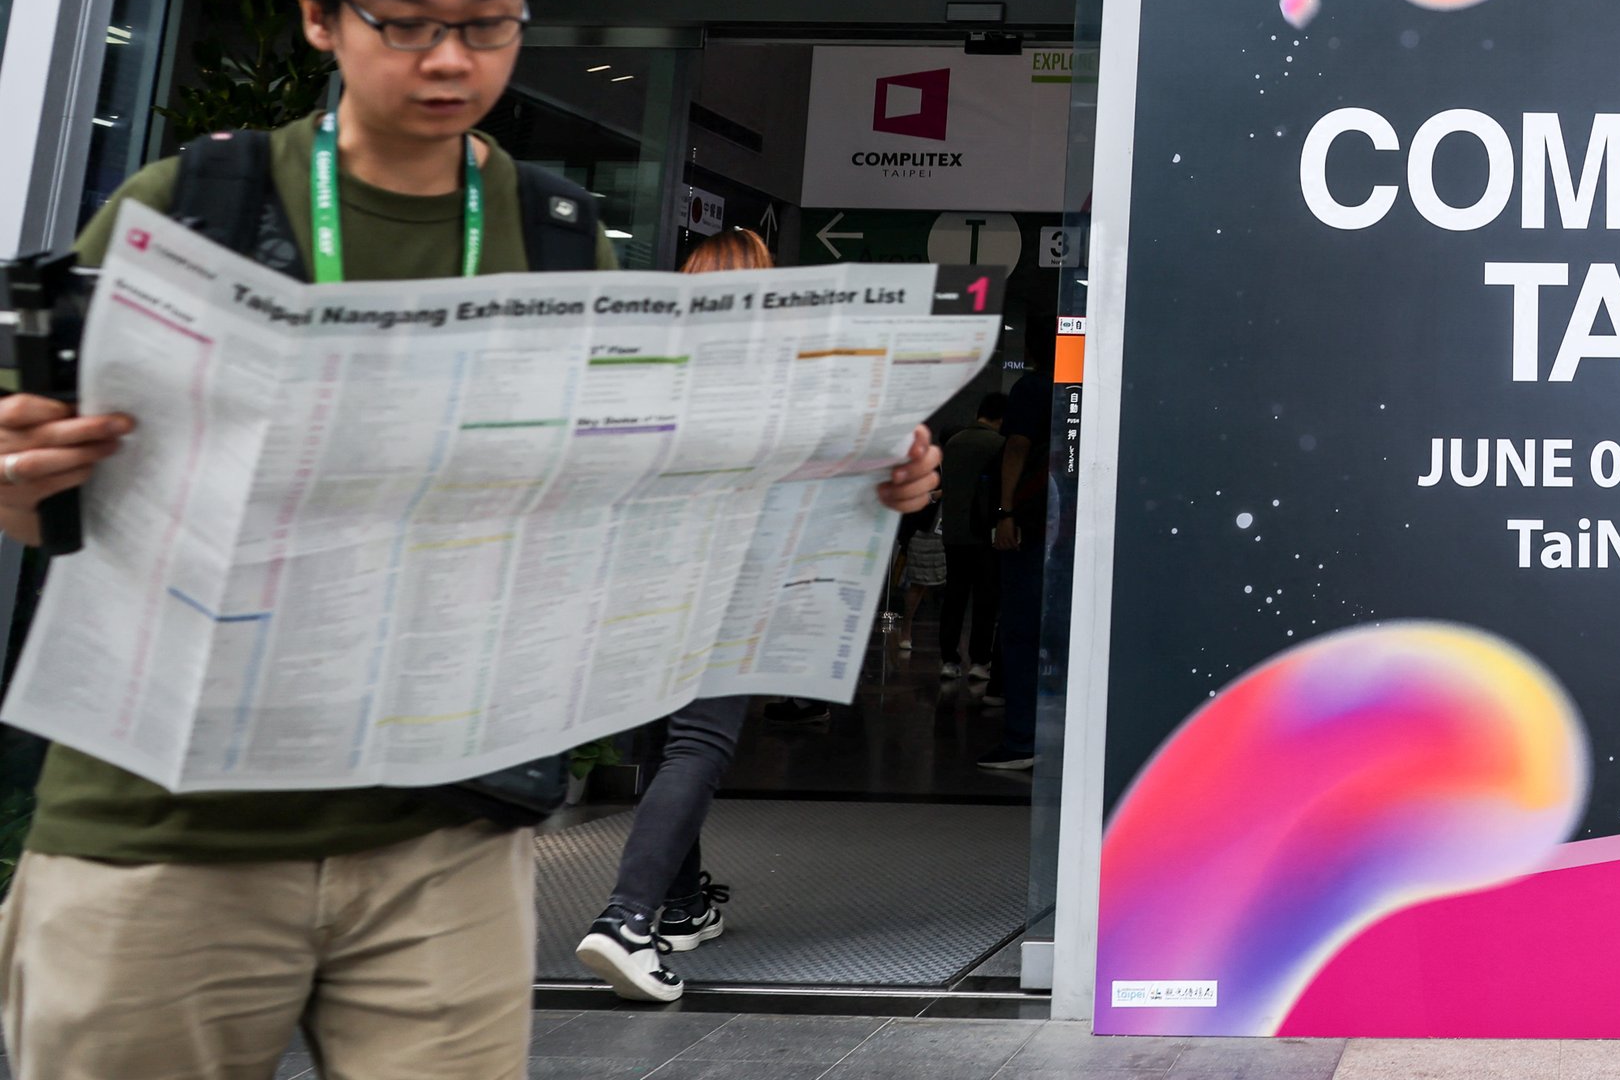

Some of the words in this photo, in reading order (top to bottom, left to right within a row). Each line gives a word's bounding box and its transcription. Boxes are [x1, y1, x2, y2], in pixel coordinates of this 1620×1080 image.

[851, 151, 963, 168] COMPUTEX
[882, 168, 933, 178] TAIPEI
[1050, 230, 1070, 258] 3
[233, 283, 312, 326] Taipei
[320, 306, 448, 329] Nangang
[455, 297, 585, 321] Exhibition
[592, 295, 682, 318] Center,
[689, 292, 734, 314] Hall
[741, 293, 753, 309] 1
[761, 288, 858, 310] Exhibitor
[864, 287, 906, 305] List
[965, 276, 991, 313] 1
[1417, 438, 1574, 488] JUNE
